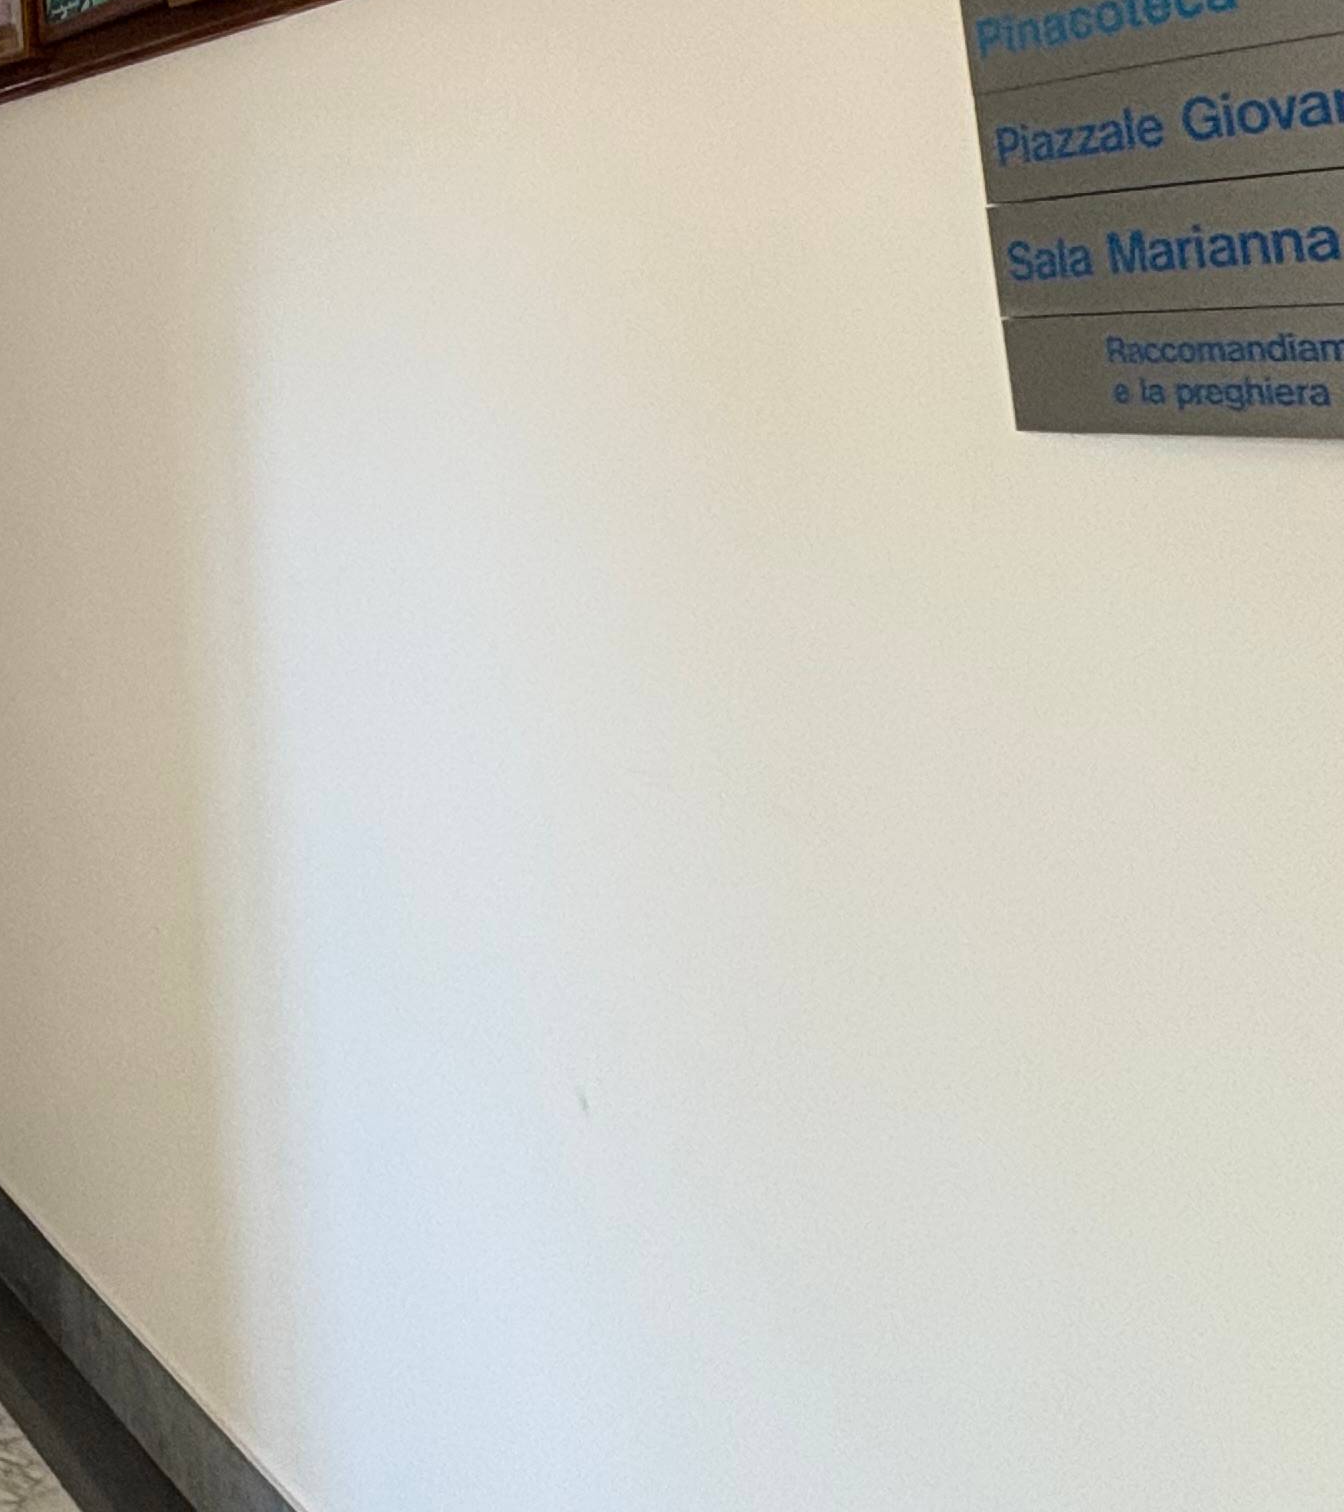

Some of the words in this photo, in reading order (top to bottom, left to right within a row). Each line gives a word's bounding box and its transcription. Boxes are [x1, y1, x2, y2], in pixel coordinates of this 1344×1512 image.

[995, 109, 1164, 166] Piazzale
[1007, 237, 1093, 282] Sala
[1107, 223, 1341, 275] Marianna
[1114, 382, 1129, 405] e
[1140, 376, 1165, 405] la
[1176, 375, 1331, 411] preghiera
